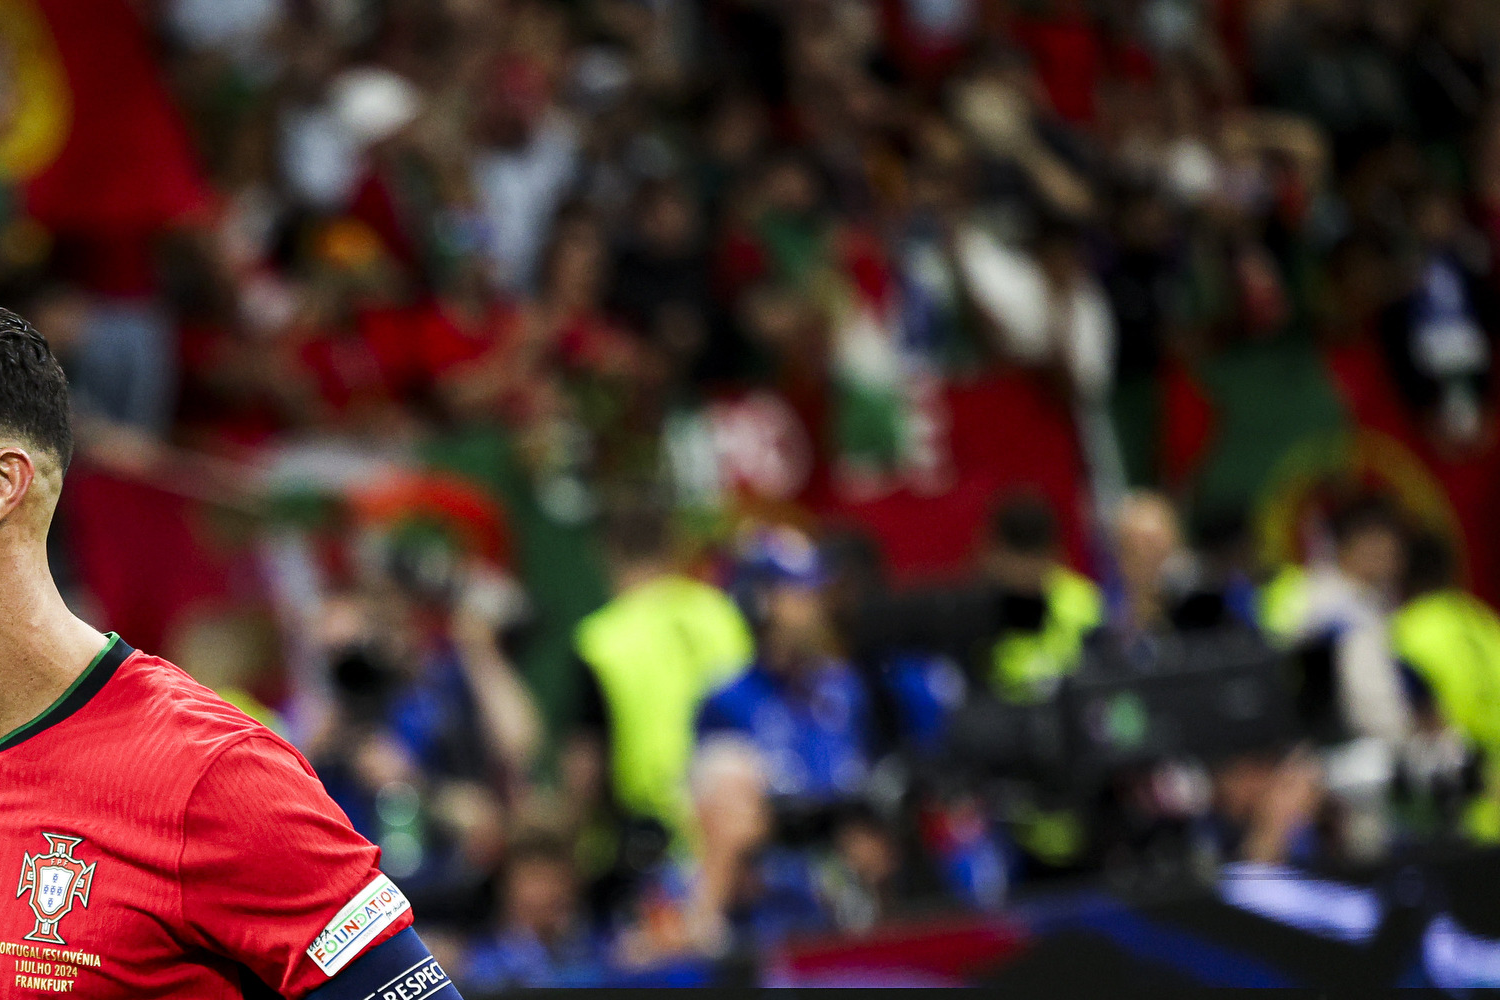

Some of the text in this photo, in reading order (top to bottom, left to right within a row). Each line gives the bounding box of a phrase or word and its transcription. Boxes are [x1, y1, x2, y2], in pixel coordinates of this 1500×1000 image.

[314, 884, 399, 963] FOUNDATION
[308, 928, 331, 952] UEFA
[15, 960, 78, 978] 1 JULHO 2024
[15, 975, 74, 992] FRANKFURT
